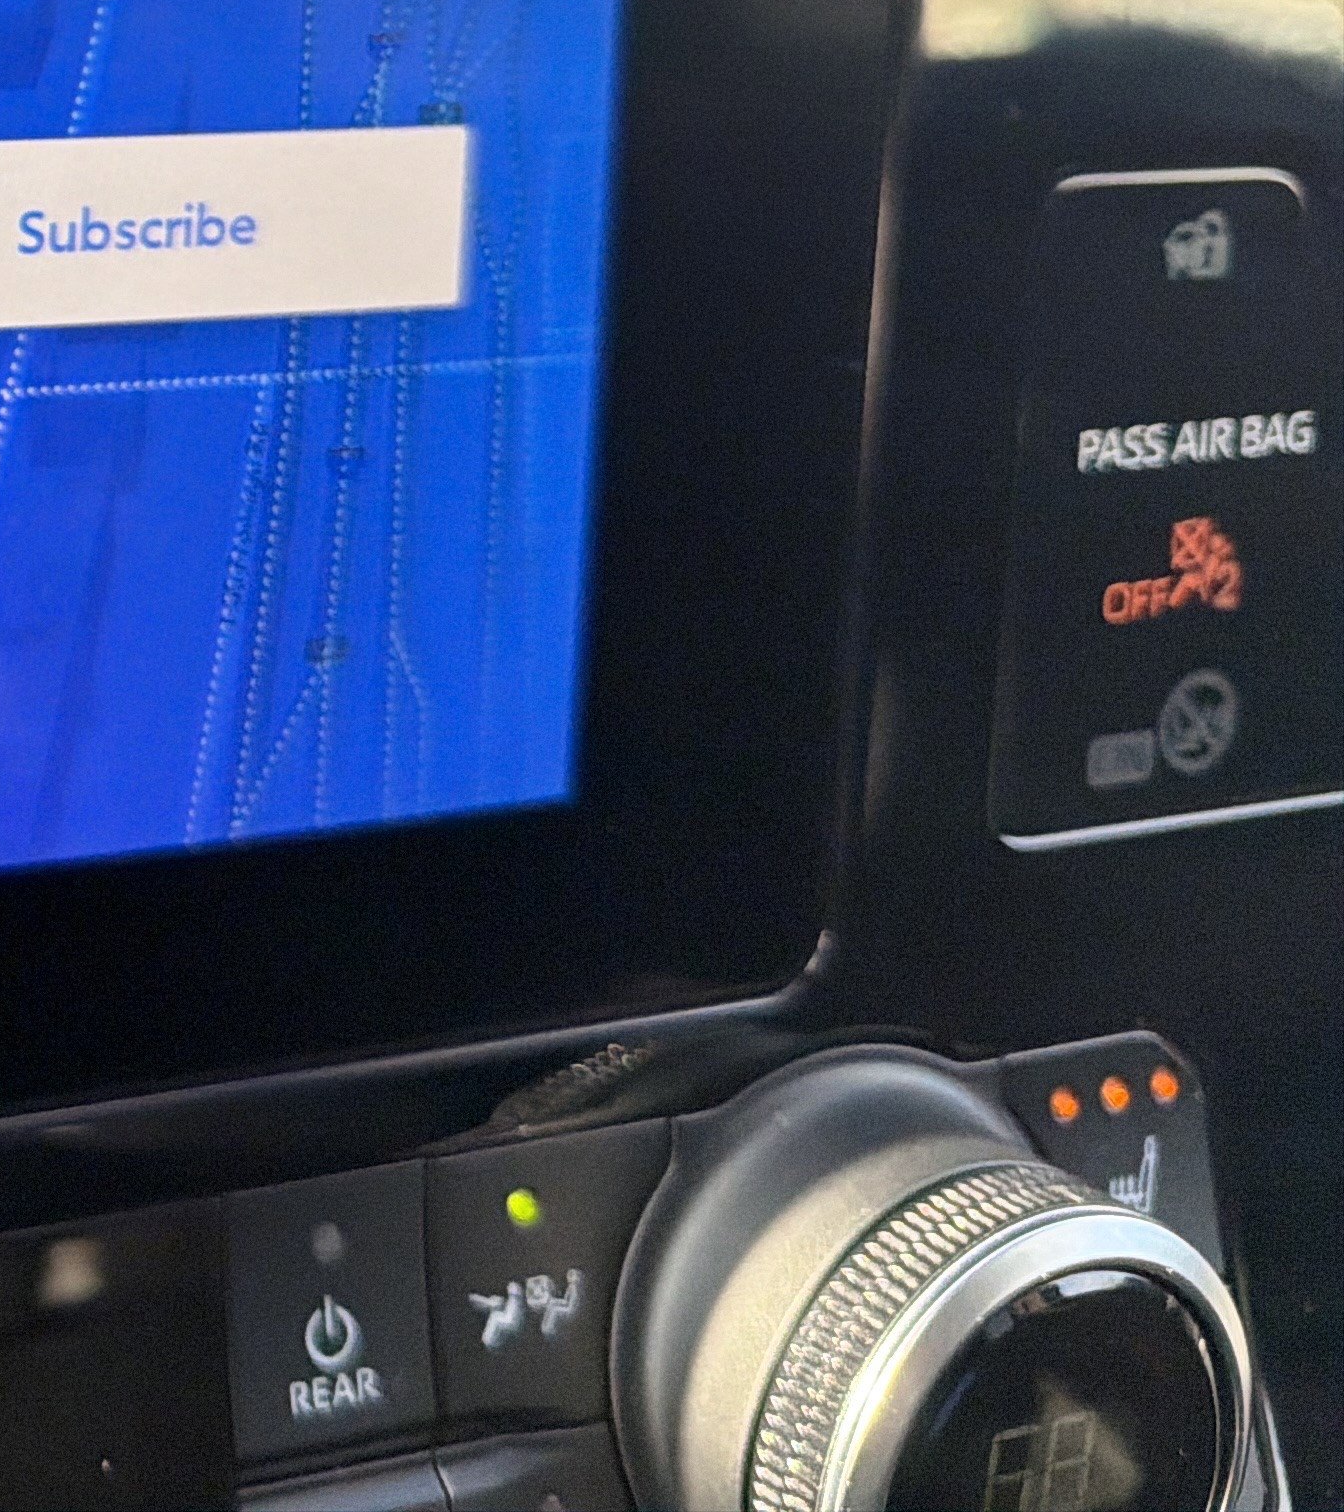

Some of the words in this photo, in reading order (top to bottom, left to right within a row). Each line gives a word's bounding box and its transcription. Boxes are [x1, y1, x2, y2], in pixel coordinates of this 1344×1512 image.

[17, 202, 257, 255] Subscribe
[1076, 422, 1170, 475] PASS
[1170, 416, 1238, 465] AIR
[1240, 409, 1318, 461] BAG
[1102, 574, 1175, 626] OFF
[288, 1366, 382, 1420] REAR
